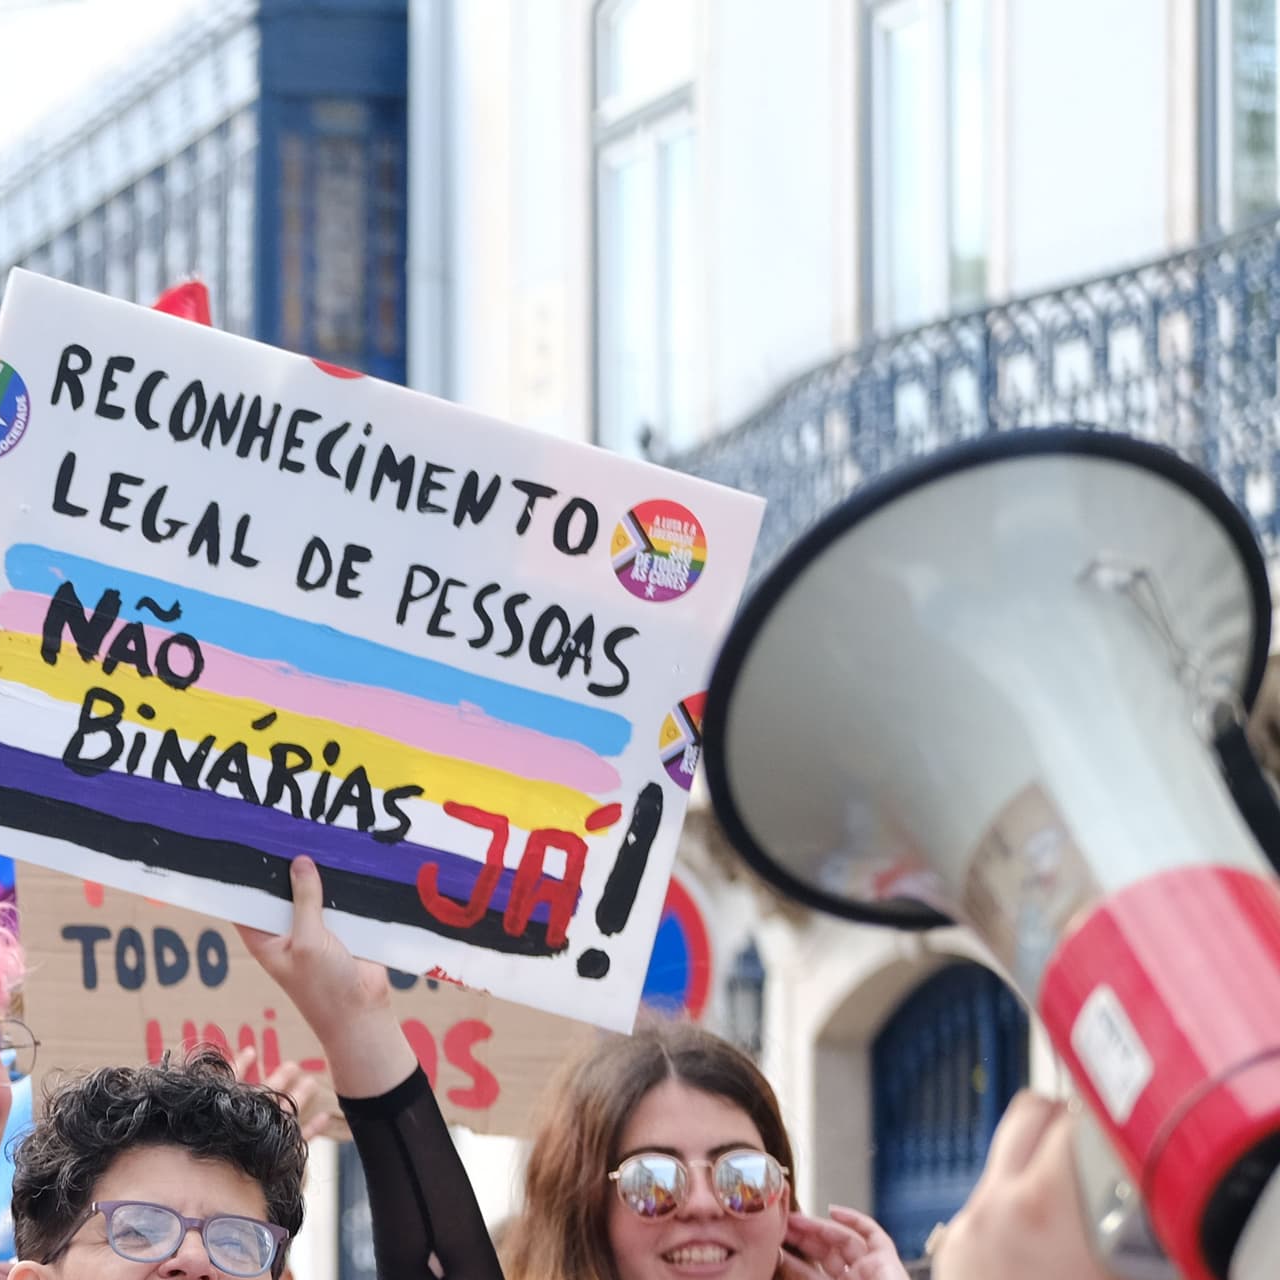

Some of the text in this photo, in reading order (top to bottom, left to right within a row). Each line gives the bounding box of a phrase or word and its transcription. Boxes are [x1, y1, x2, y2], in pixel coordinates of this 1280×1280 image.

[41, 581, 204, 690] NÃO
[52, 452, 639, 697] LEGAL DE PESSOAS
